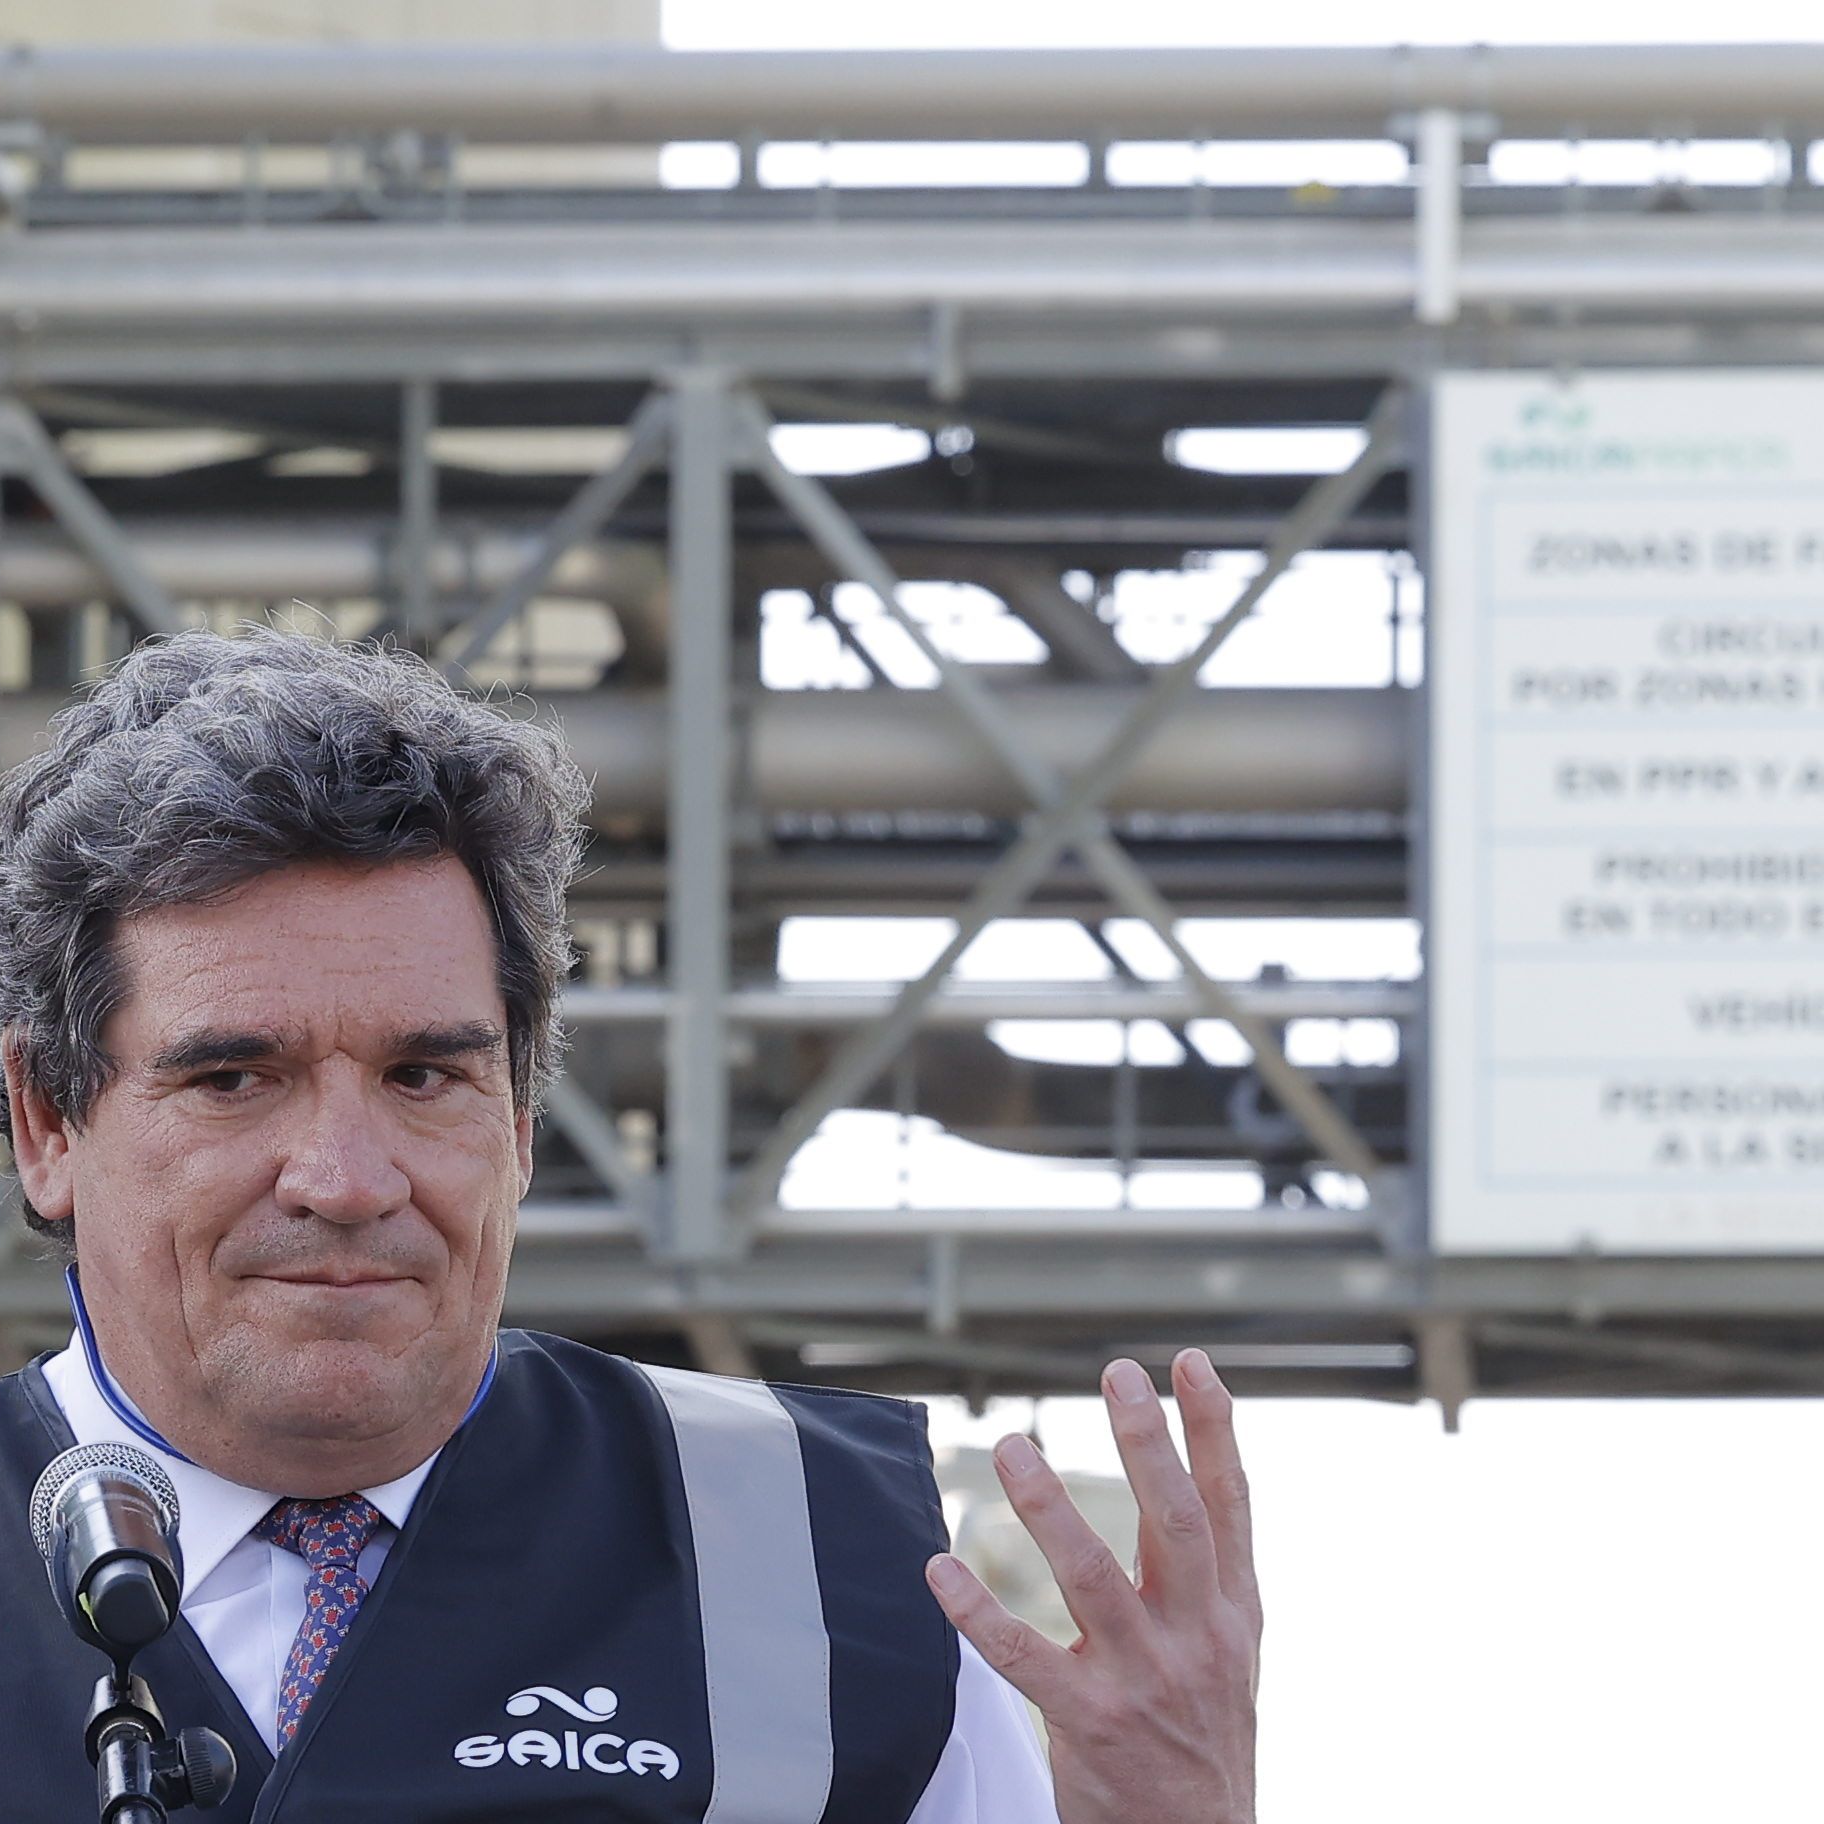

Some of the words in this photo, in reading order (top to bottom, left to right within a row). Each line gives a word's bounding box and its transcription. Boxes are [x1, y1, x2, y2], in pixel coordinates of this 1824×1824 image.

[1528, 532, 1698, 574] ZONAS
[1713, 532, 1778, 574] DE
[1511, 669, 1619, 708] POR
[1633, 669, 1803, 708] ZONAS
[1555, 757, 1625, 798] EN
[1563, 898, 1634, 939] EN
[1649, 898, 1789, 939] TODO
[1653, 1129, 1692, 1168] A
[1702, 1129, 1770, 1168] LA
[454, 1730, 680, 1781] SAICA
